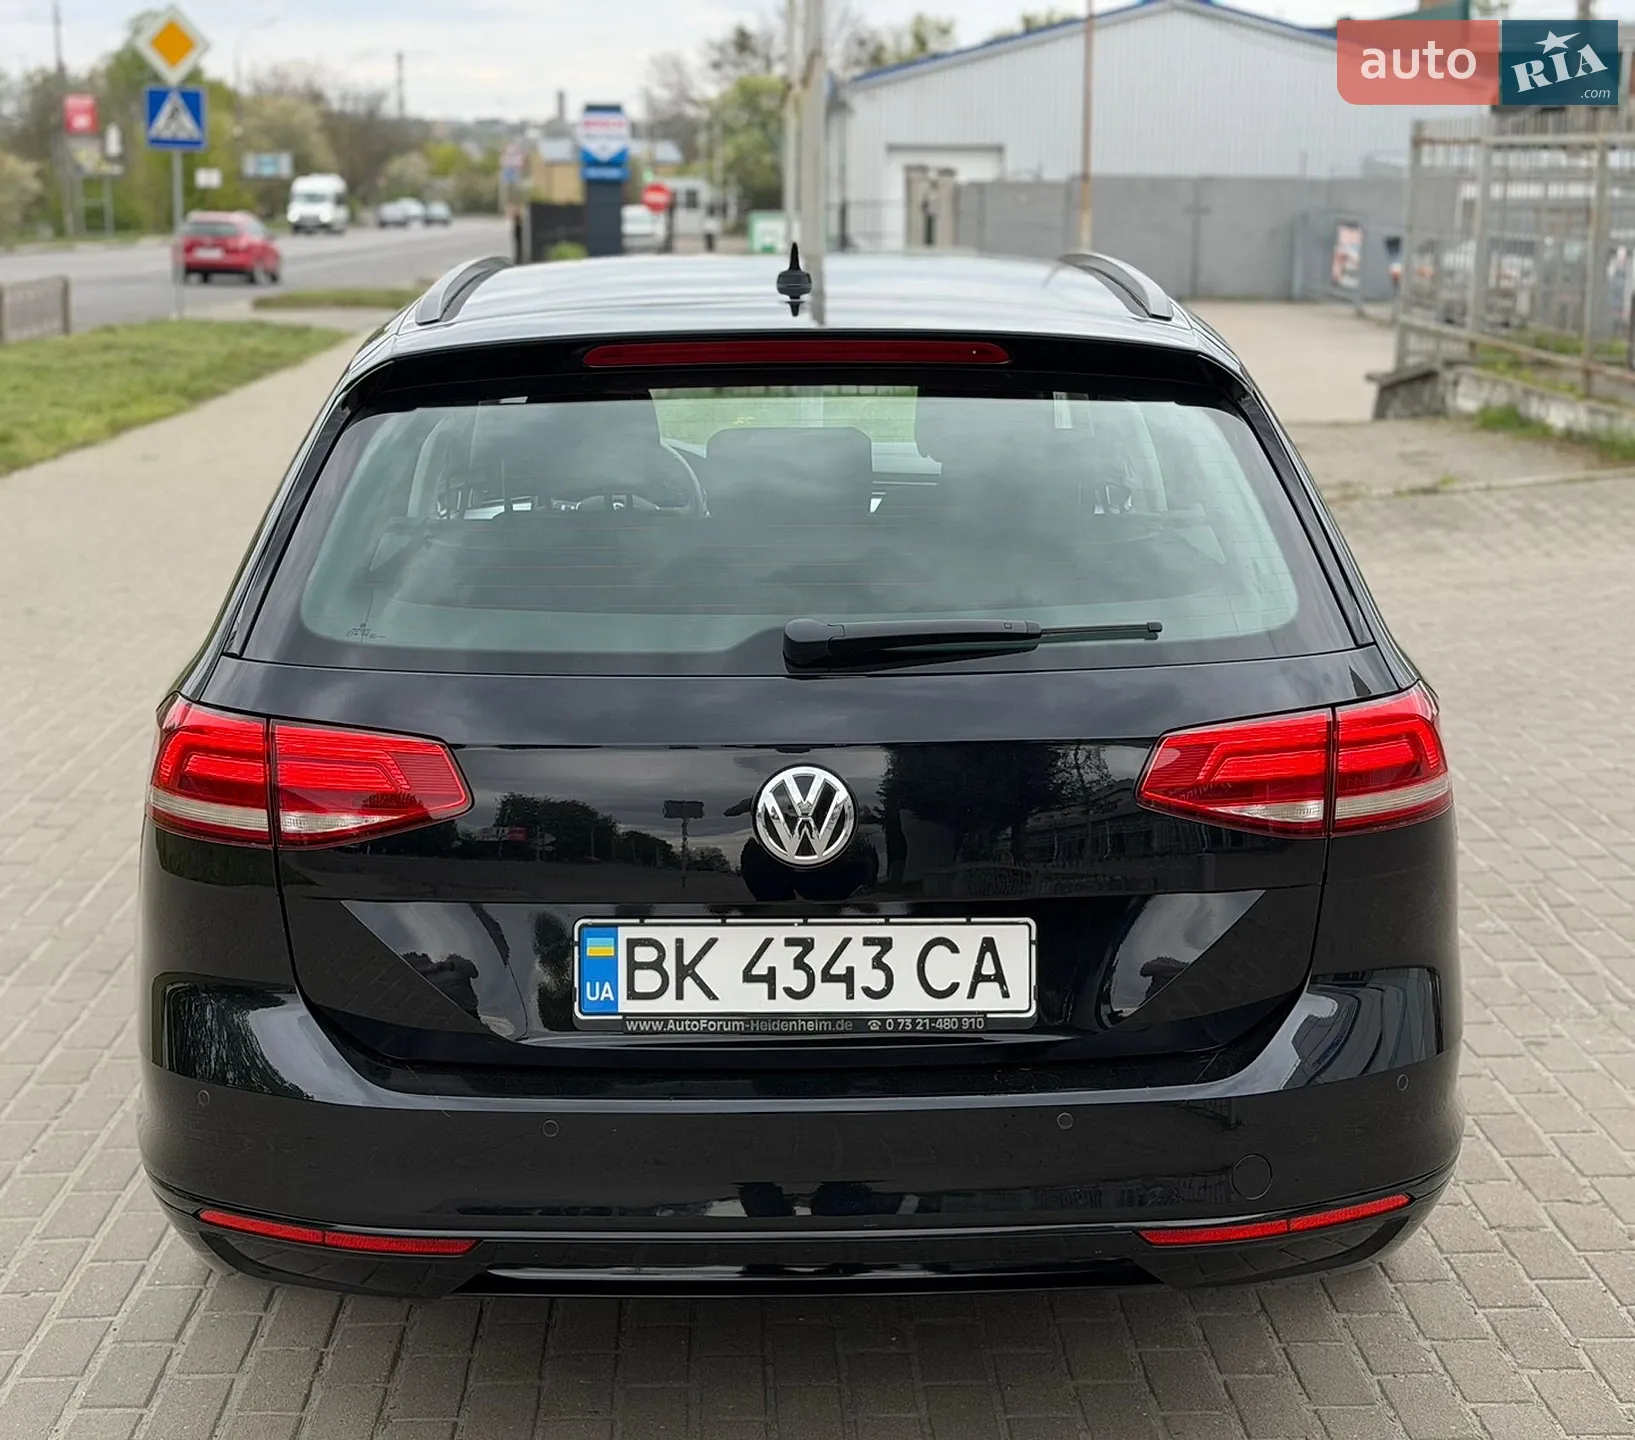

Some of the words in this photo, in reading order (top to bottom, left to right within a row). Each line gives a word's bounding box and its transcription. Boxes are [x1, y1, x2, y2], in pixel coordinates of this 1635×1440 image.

[625, 937, 719, 1001] BK
[742, 937, 894, 1000] 4343
[916, 937, 1011, 1000] CA
[586, 981, 615, 1001] UA
[625, 1018, 853, 1032] www.AutoForum-Heidenheim.de
